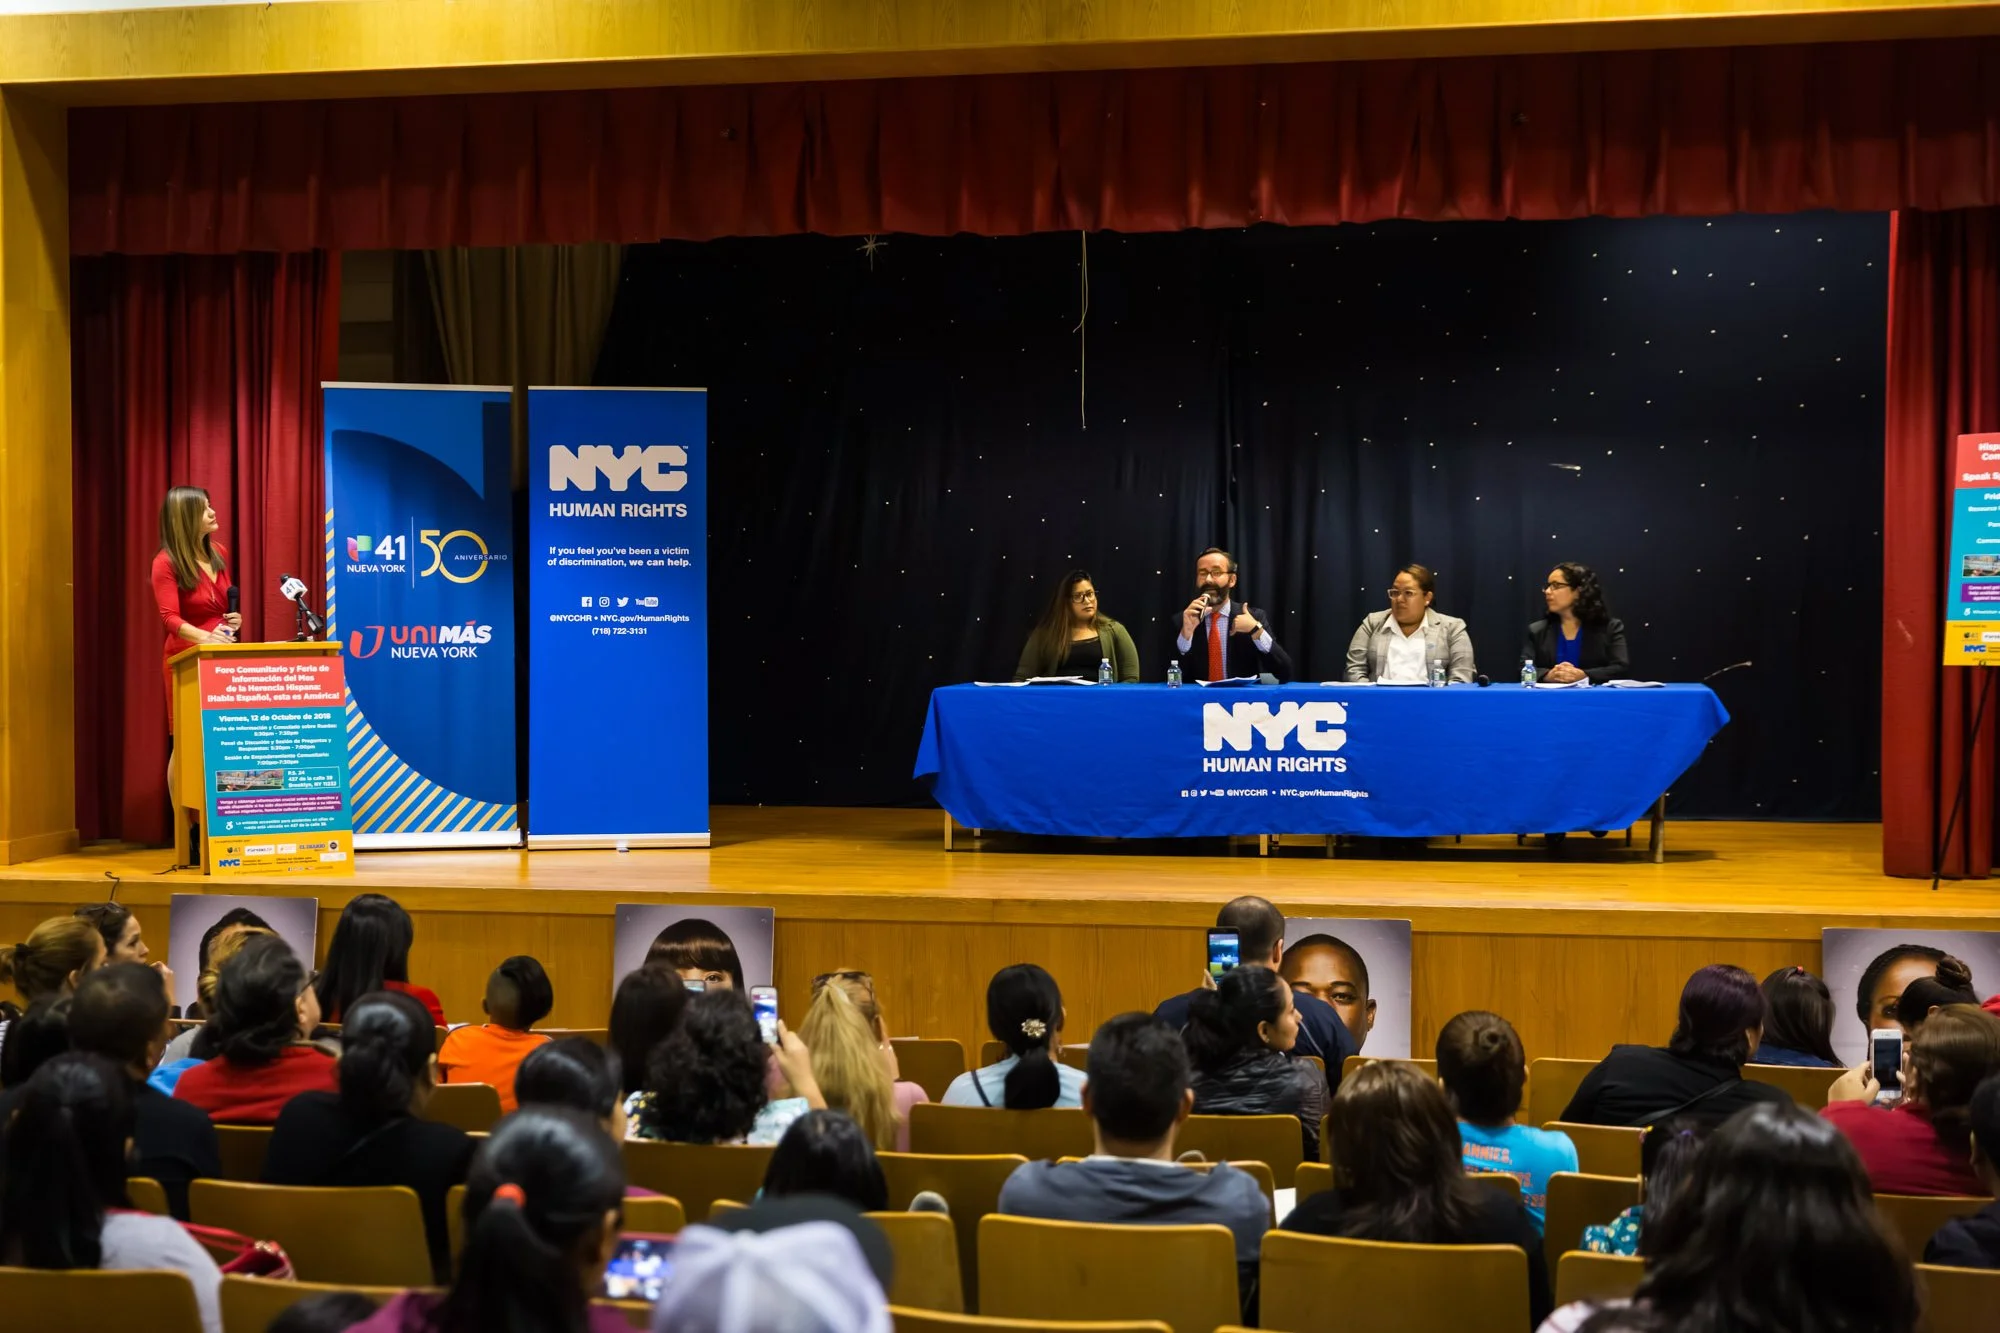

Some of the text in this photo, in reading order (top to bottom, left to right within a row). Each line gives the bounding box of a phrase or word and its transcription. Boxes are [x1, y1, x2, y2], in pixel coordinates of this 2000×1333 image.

[549, 444, 688, 492] NYC
[549, 502, 688, 518] HUMAN RIGHTS
[375, 535, 406, 561] 41
[549, 546, 557, 555] If
[558, 547, 576, 557] you
[577, 546, 595, 555] feel
[597, 546, 627, 557] you've
[629, 546, 652, 555] been
[661, 546, 690, 555] victim
[420, 529, 489, 584] 50
[347, 564, 406, 573] NUEVA YORK
[547, 558, 692, 569] of discrimination, we can help.
[549, 614, 690, 624] @NYCCHR NYC.gov/HumanRights
[591, 627, 648, 636] (718) 722-3131
[391, 646, 478, 659] NUEVA YORK
[215, 664, 330, 674] Foro Comunitario y Feria de
[231, 674, 315, 683] Información del Mes
[225, 684, 237, 692] de
[238, 684, 247, 692] la
[247, 683, 285, 692] Herencia
[273, 693, 291, 701] esta
[292, 693, 302, 701] es
[270, 713, 302, 721] Octubre
[302, 712, 313, 720] de
[1202, 701, 1347, 752] NYC
[1203, 756, 1347, 773] HUMAN RIGHTS
[1226, 788, 1268, 798] @NYCCHR
[1280, 788, 1369, 799] NYC.gov/HumanRights
[218, 858, 241, 868] NYC
